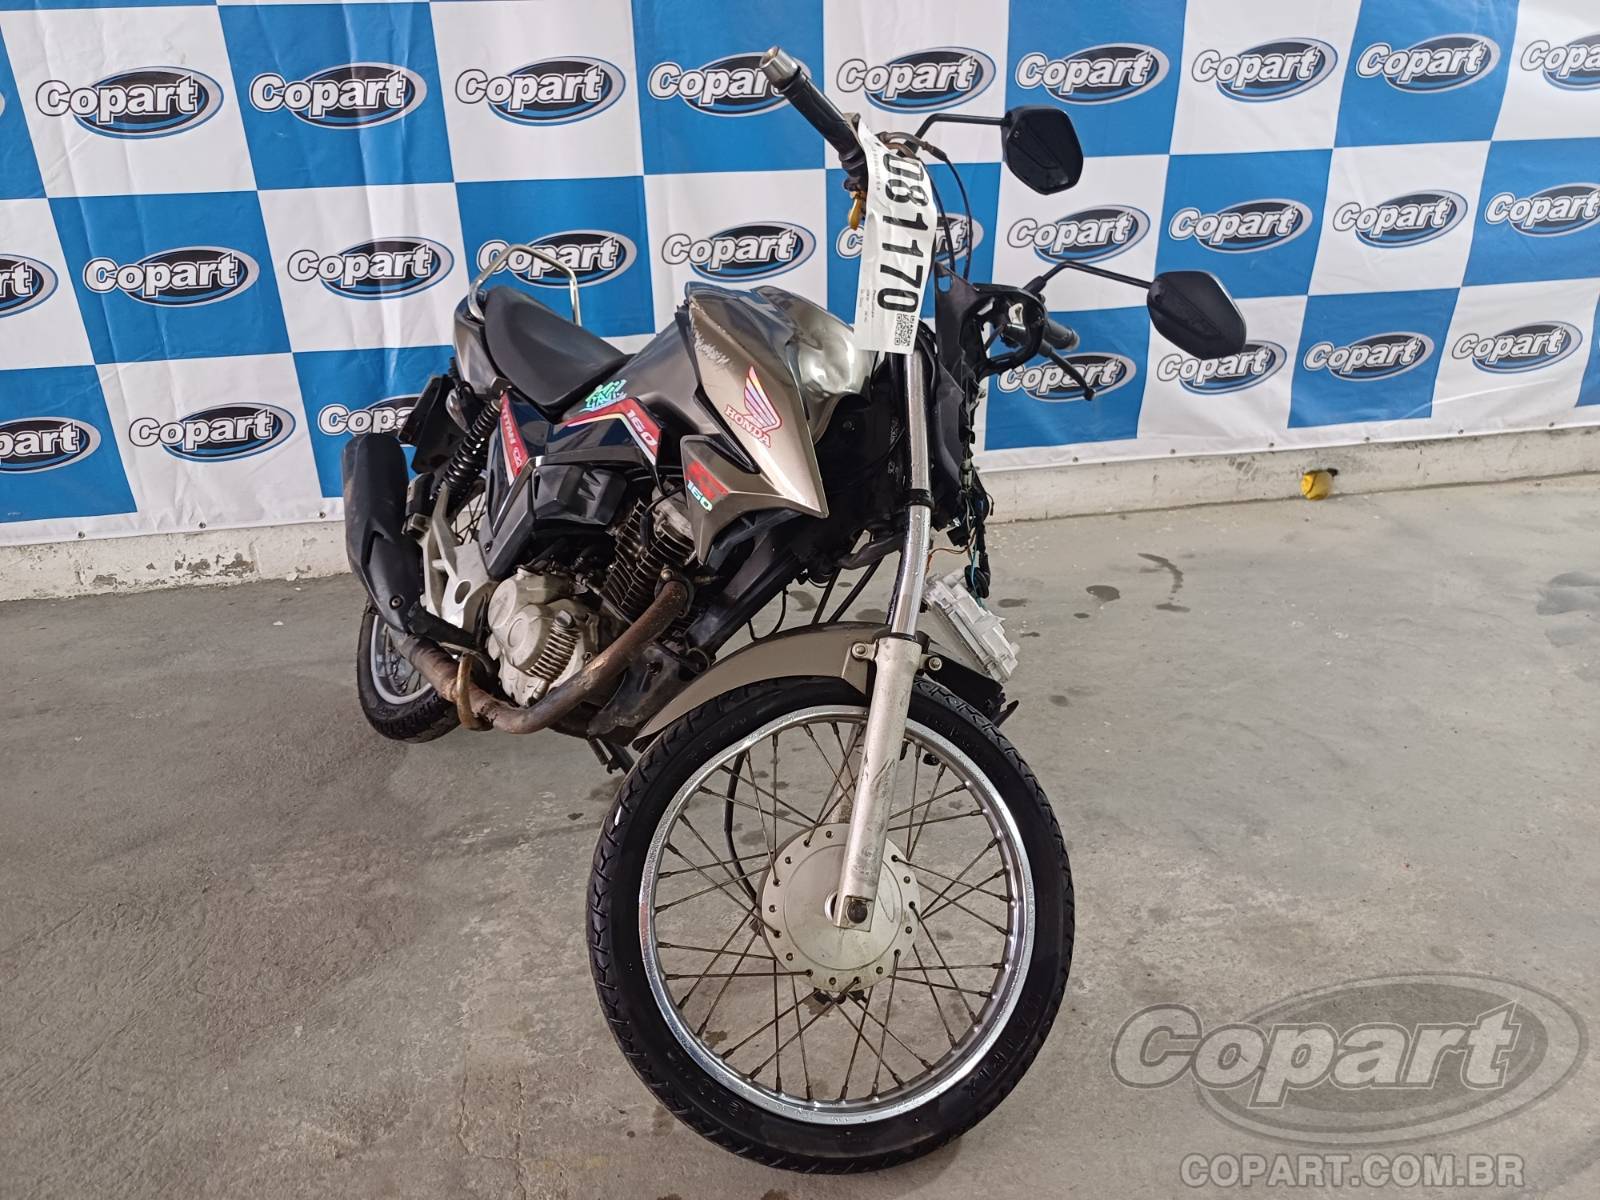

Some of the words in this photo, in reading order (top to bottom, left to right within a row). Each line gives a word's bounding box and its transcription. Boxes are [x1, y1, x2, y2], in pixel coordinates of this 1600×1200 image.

[648, 62, 787, 105] Copar
[837, 57, 978, 103] Copart
[1016, 52, 1157, 95] Copart
[1193, 49, 1325, 91] Copart
[1357, 42, 1486, 83] Copart
[36, 75, 200, 122] Copart
[249, 71, 406, 116] Copart
[456, 67, 604, 110] Copart
[1169, 206, 1298, 247] Copart
[1334, 193, 1453, 234] Copart
[1485, 189, 1600, 229] Copart
[877, 153, 929, 313] 081170
[1007, 212, 1135, 253] Copart
[288, 247, 438, 290] Copart
[477, 236, 619, 280] Copart
[662, 233, 806, 276] Copart
[84, 257, 240, 297] Copart
[1157, 344, 1276, 386] Copart
[1304, 341, 1424, 379] Copart
[1452, 326, 1567, 367] Copart
[129, 413, 275, 449] Copart
[626, 409, 658, 447] 160
[724, 404, 772, 449] HONDA
[687, 479, 713, 512] 160
